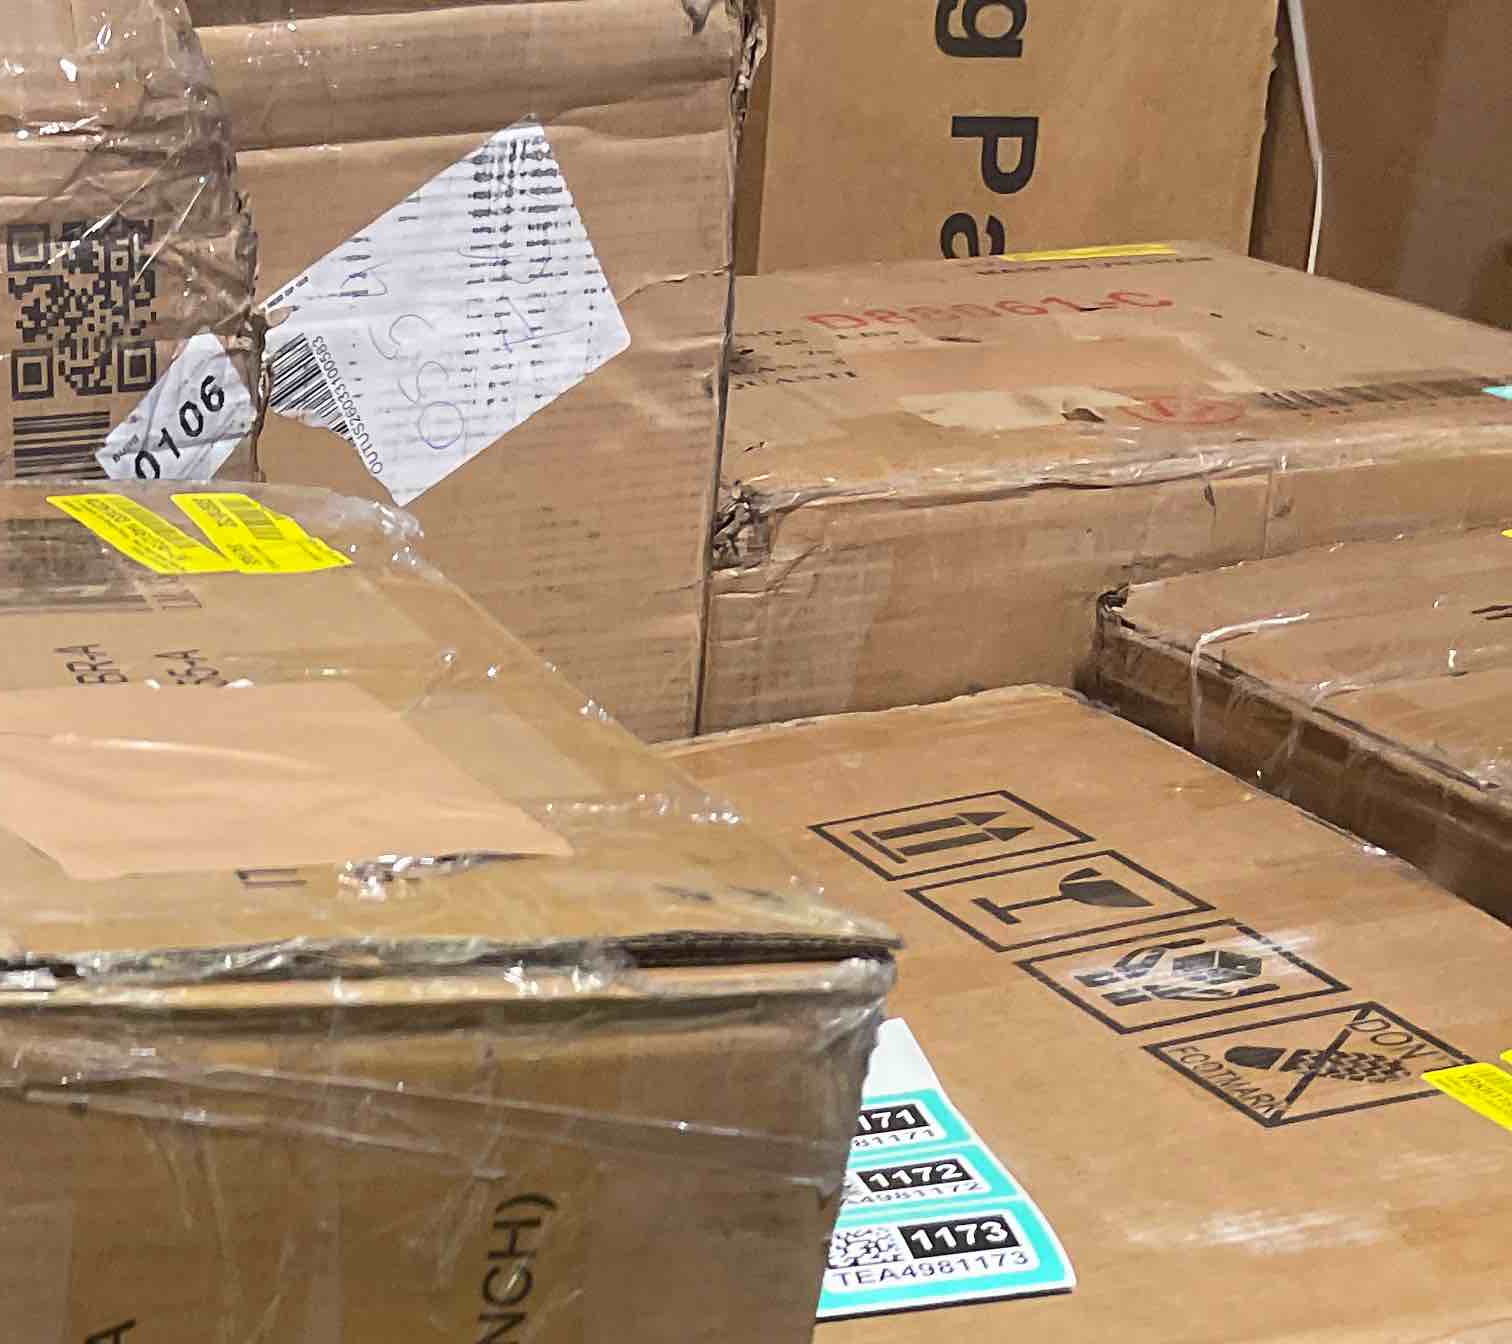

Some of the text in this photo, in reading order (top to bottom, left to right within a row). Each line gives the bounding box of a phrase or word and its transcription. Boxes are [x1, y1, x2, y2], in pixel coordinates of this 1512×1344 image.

[134, 375, 225, 479] 0106
[869, 1163, 963, 1190] 1172
[911, 1220, 1008, 1251] 1173
[832, 1250, 1029, 1287] TEA4981173
